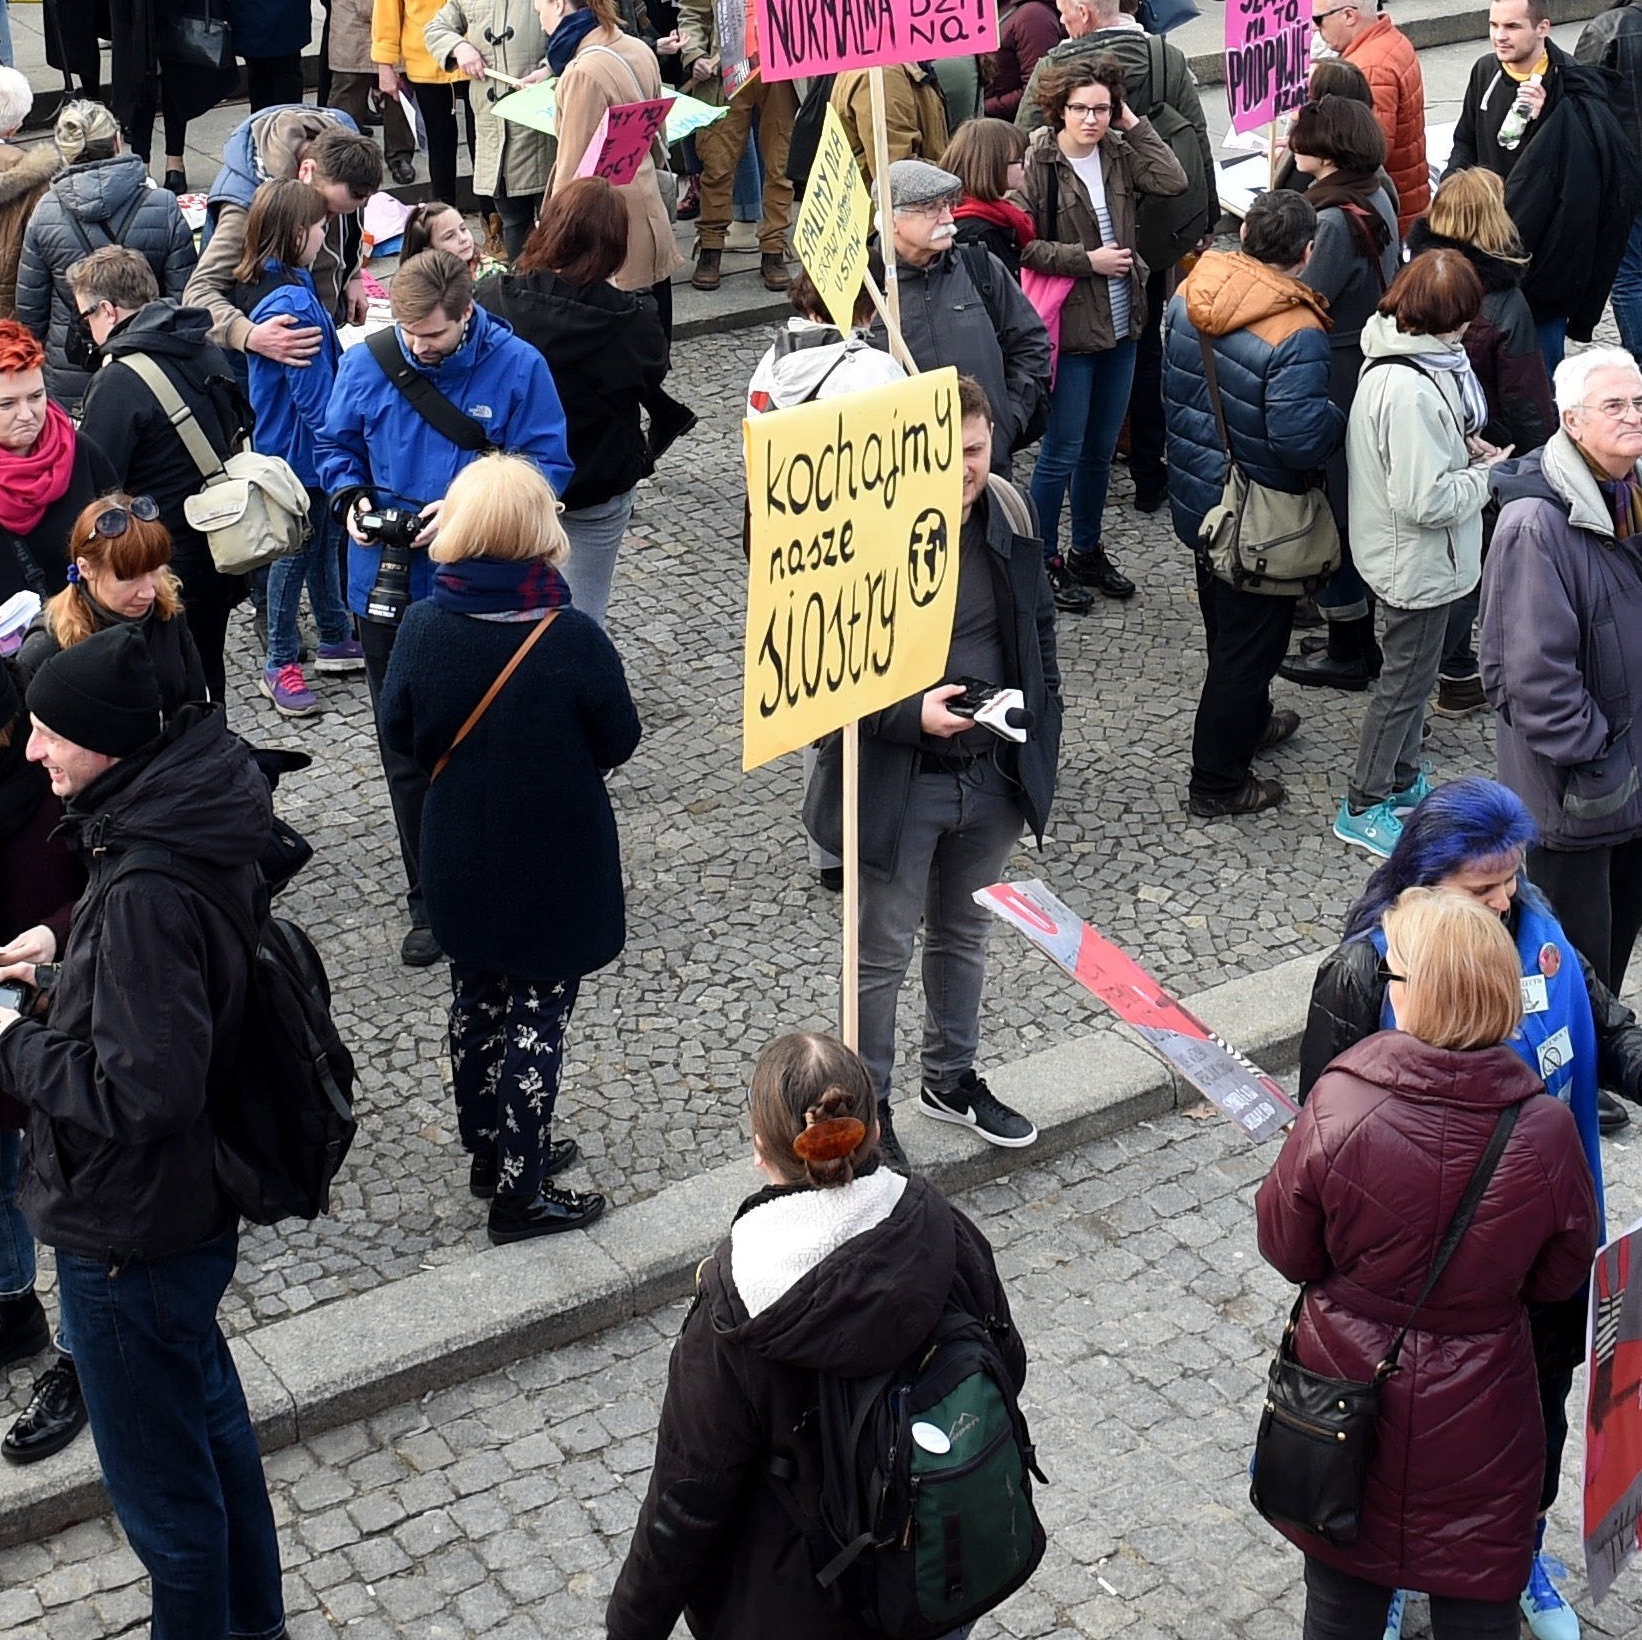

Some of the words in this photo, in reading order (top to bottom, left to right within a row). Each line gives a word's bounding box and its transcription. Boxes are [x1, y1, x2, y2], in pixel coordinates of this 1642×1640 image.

[1273, 6, 1299, 29] TO
[766, 387, 953, 518] kochajmy
[769, 518, 855, 585] nasze
[759, 565, 900, 718] siostry
